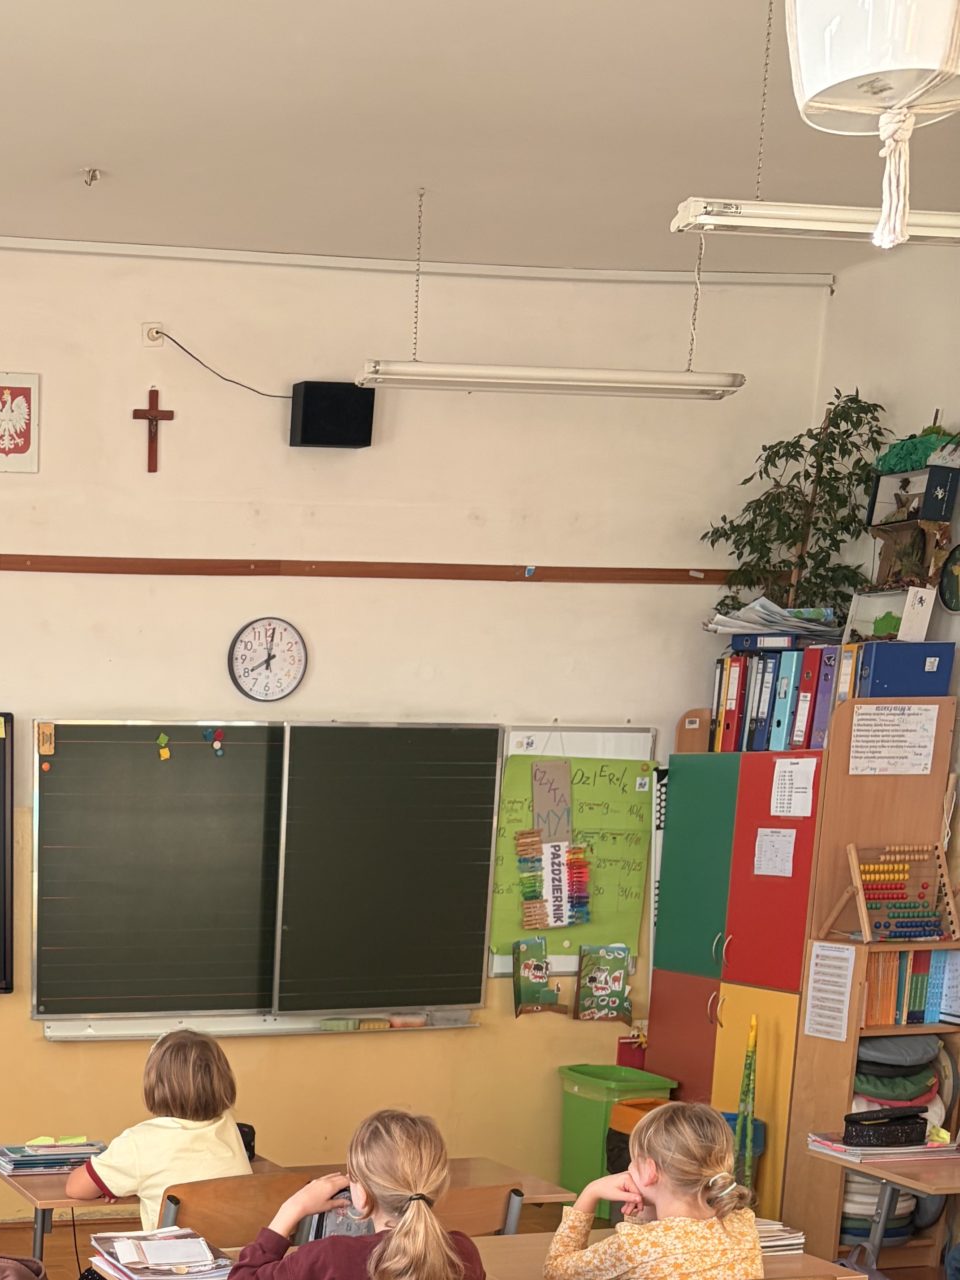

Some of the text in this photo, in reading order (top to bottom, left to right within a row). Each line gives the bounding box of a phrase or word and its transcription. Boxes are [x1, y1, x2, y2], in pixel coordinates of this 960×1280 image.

[254, 631, 260, 640] 11
[243, 641, 253, 651] 10
[287, 642, 294, 652] 2
[241, 654, 247, 664] 9
[289, 655, 296, 666] 3
[243, 668, 249, 678] 8
[252, 678, 258, 688] 7
[264, 682, 270, 692] 6
[276, 678, 282, 688] 5
[550, 844, 564, 924] PAŹDZIERNIK
